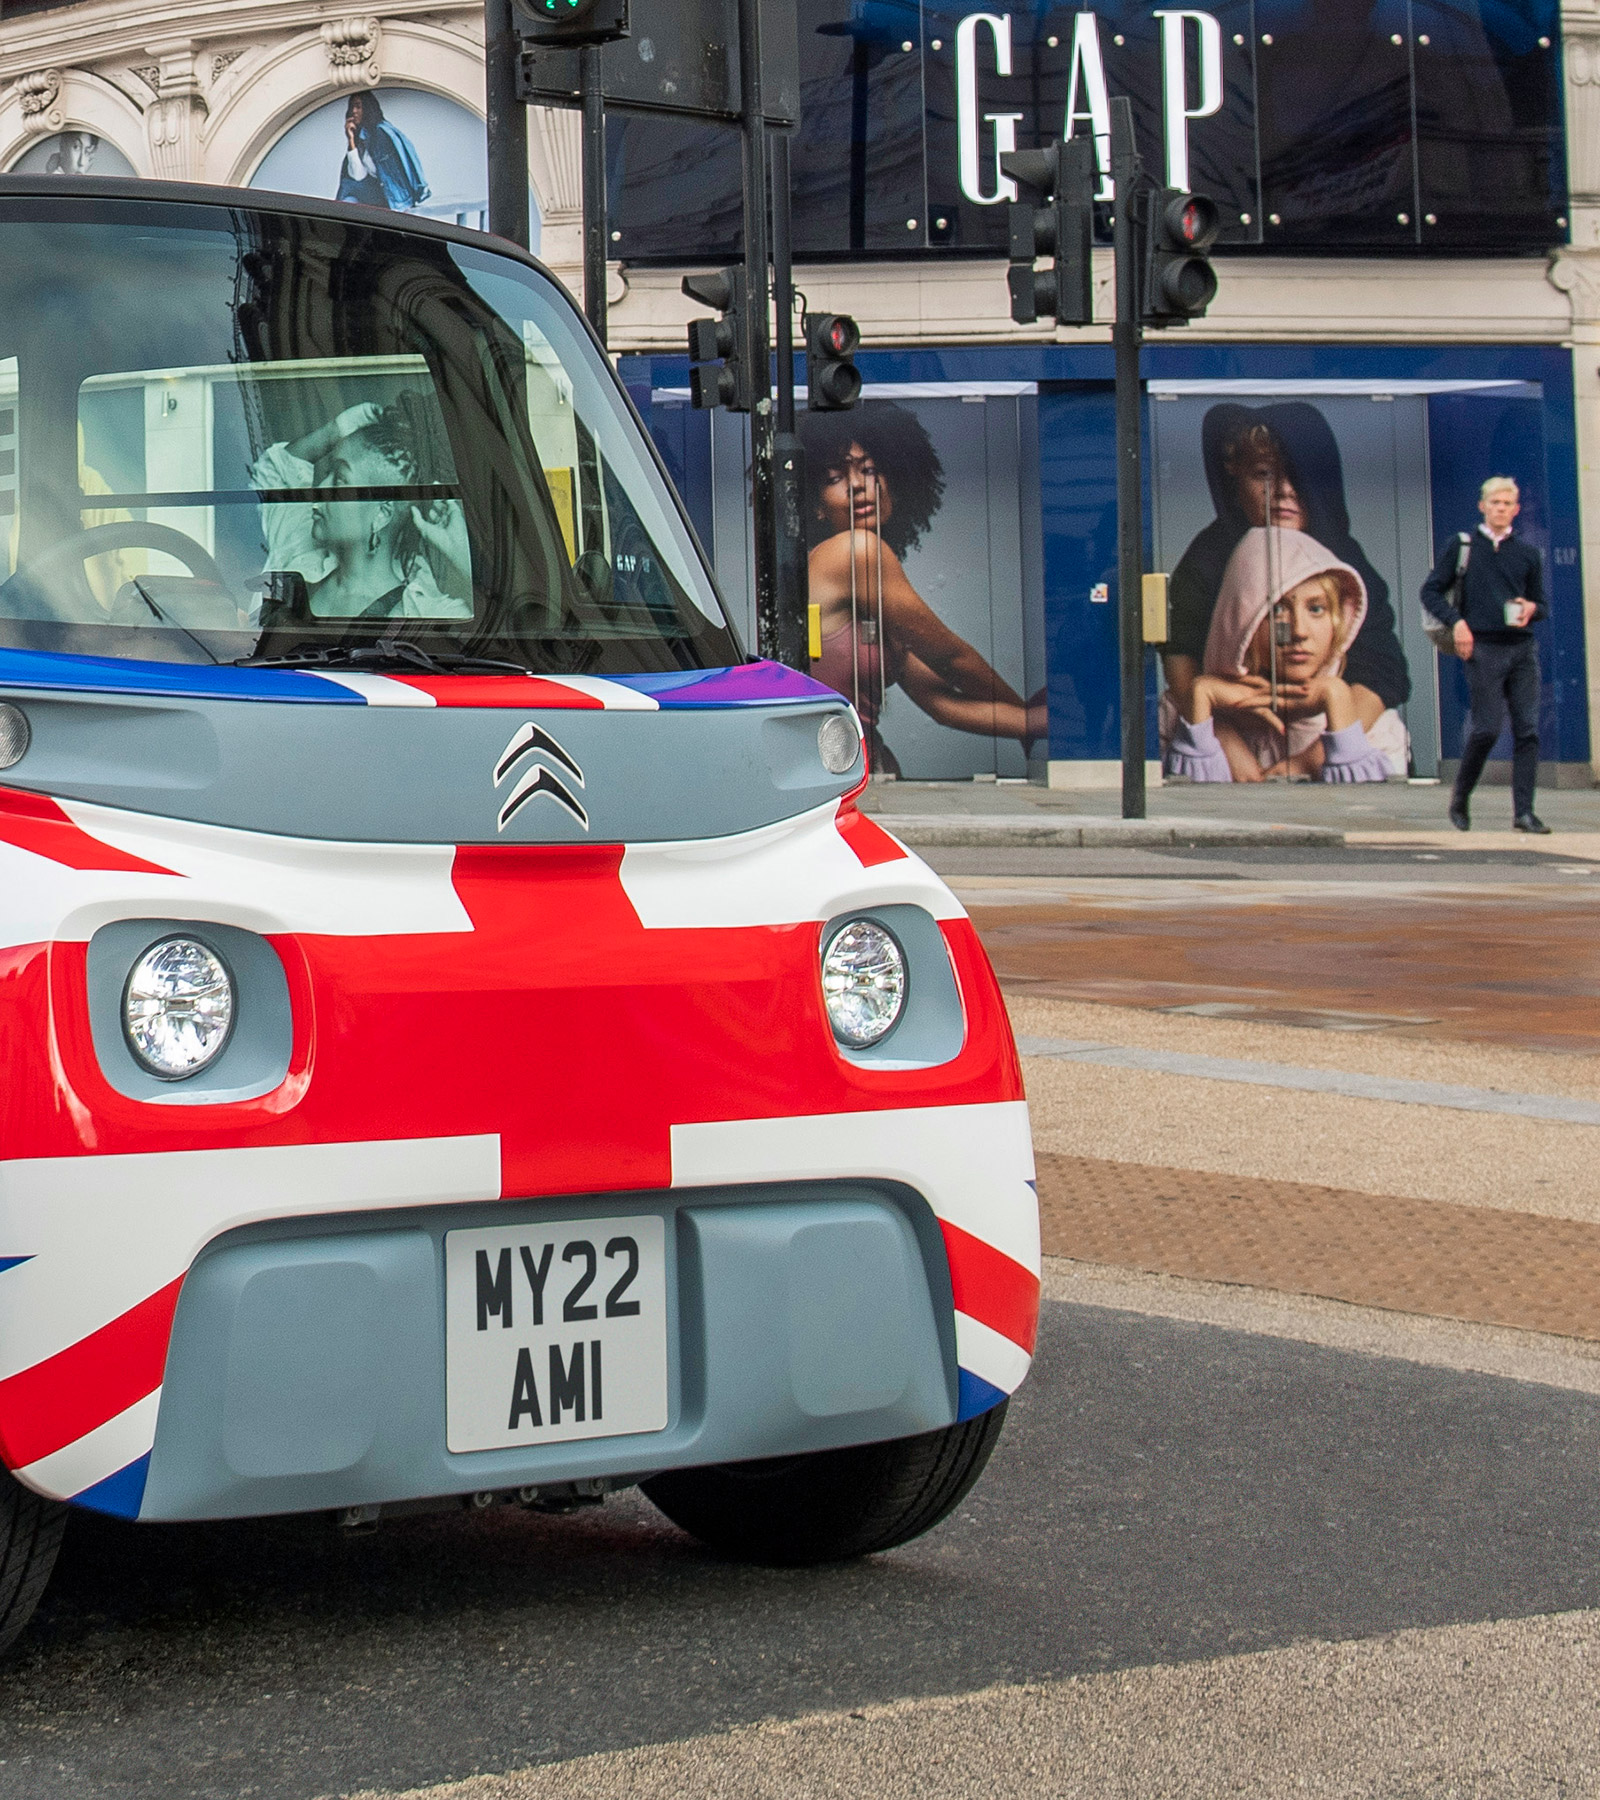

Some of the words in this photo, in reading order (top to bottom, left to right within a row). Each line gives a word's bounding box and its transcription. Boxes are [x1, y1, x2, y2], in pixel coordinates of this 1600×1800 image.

[955, 10, 1223, 205] GAP
[616, 554, 637, 572] GAP
[476, 1236, 640, 1331] MY22
[508, 1340, 603, 1430] AMI
